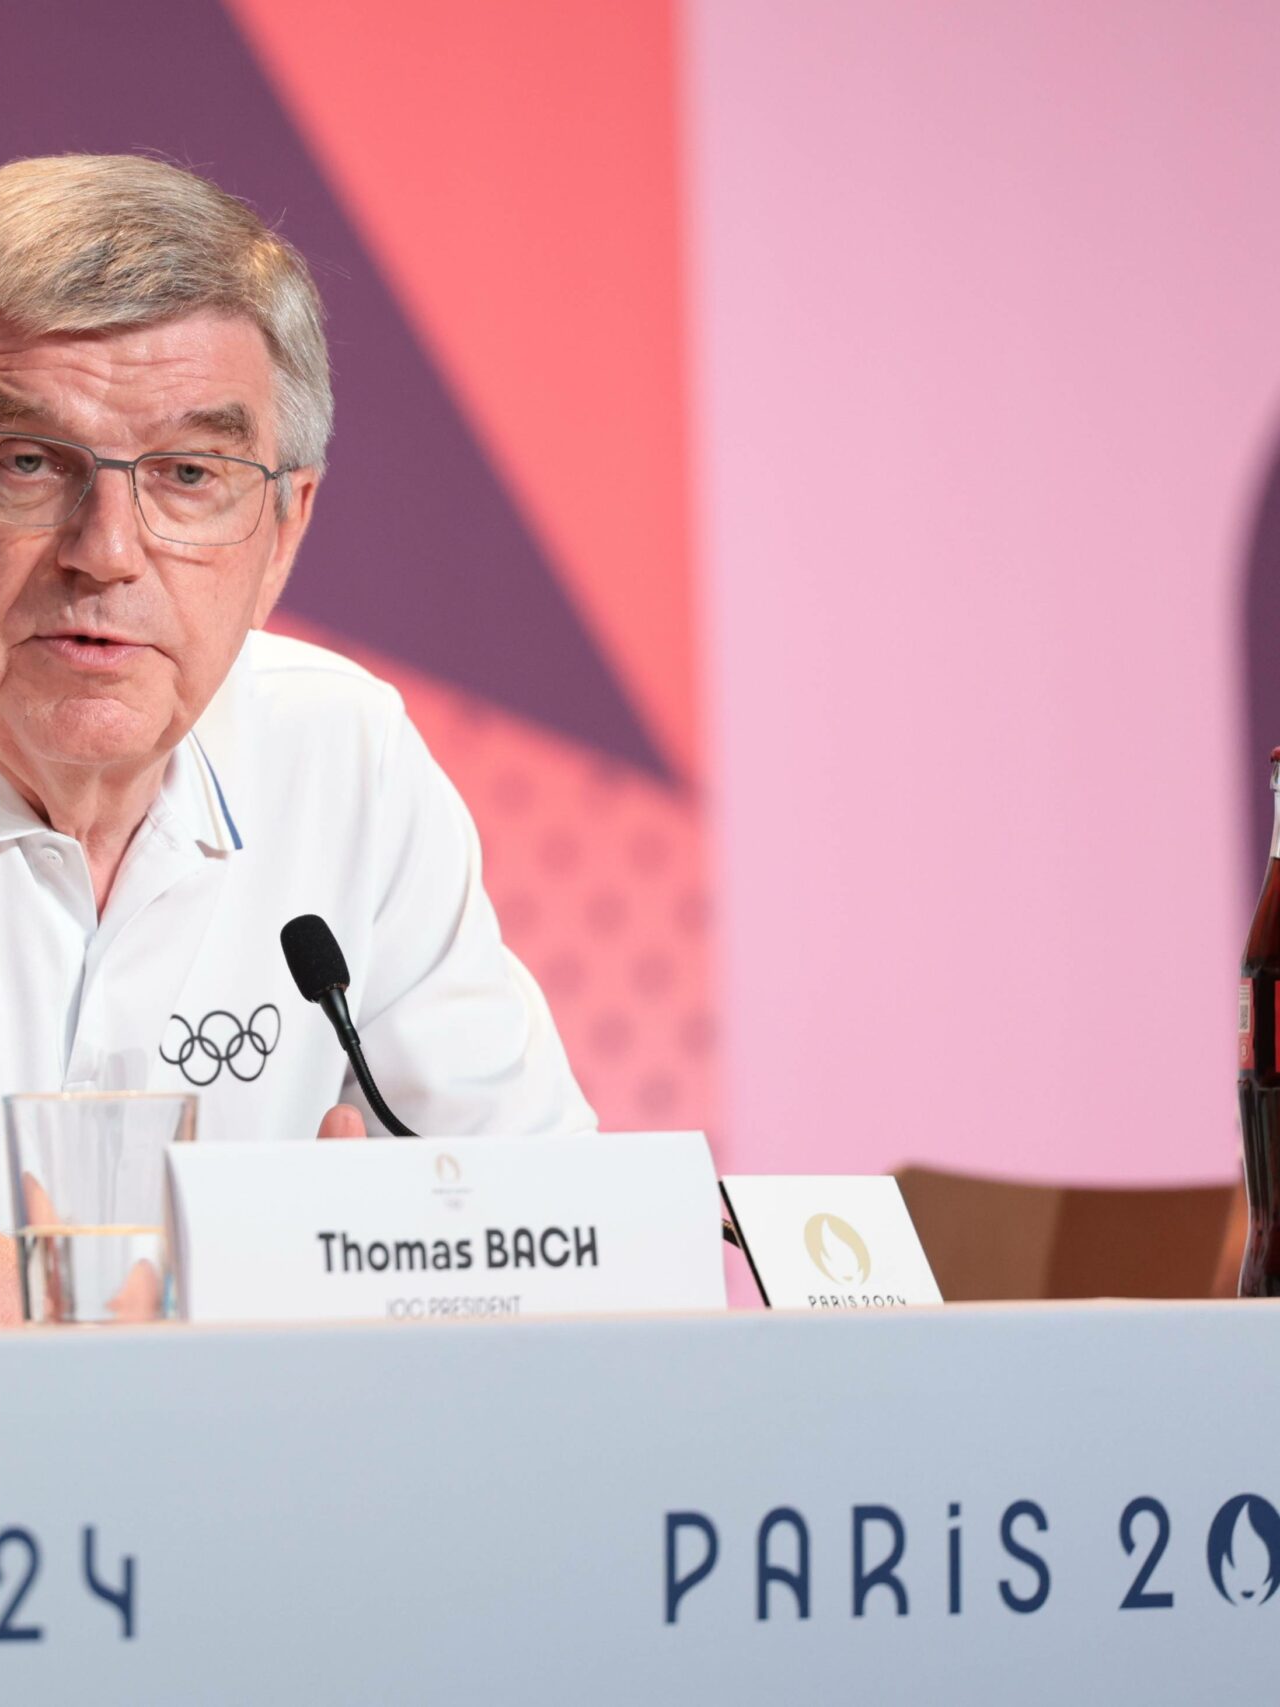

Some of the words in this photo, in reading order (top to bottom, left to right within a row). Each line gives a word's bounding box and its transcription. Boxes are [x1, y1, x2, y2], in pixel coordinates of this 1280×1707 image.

[317, 1231, 473, 1273] Thomas
[485, 1226, 600, 1270] BACH
[427, 1294, 522, 1316] PRESIDENT
